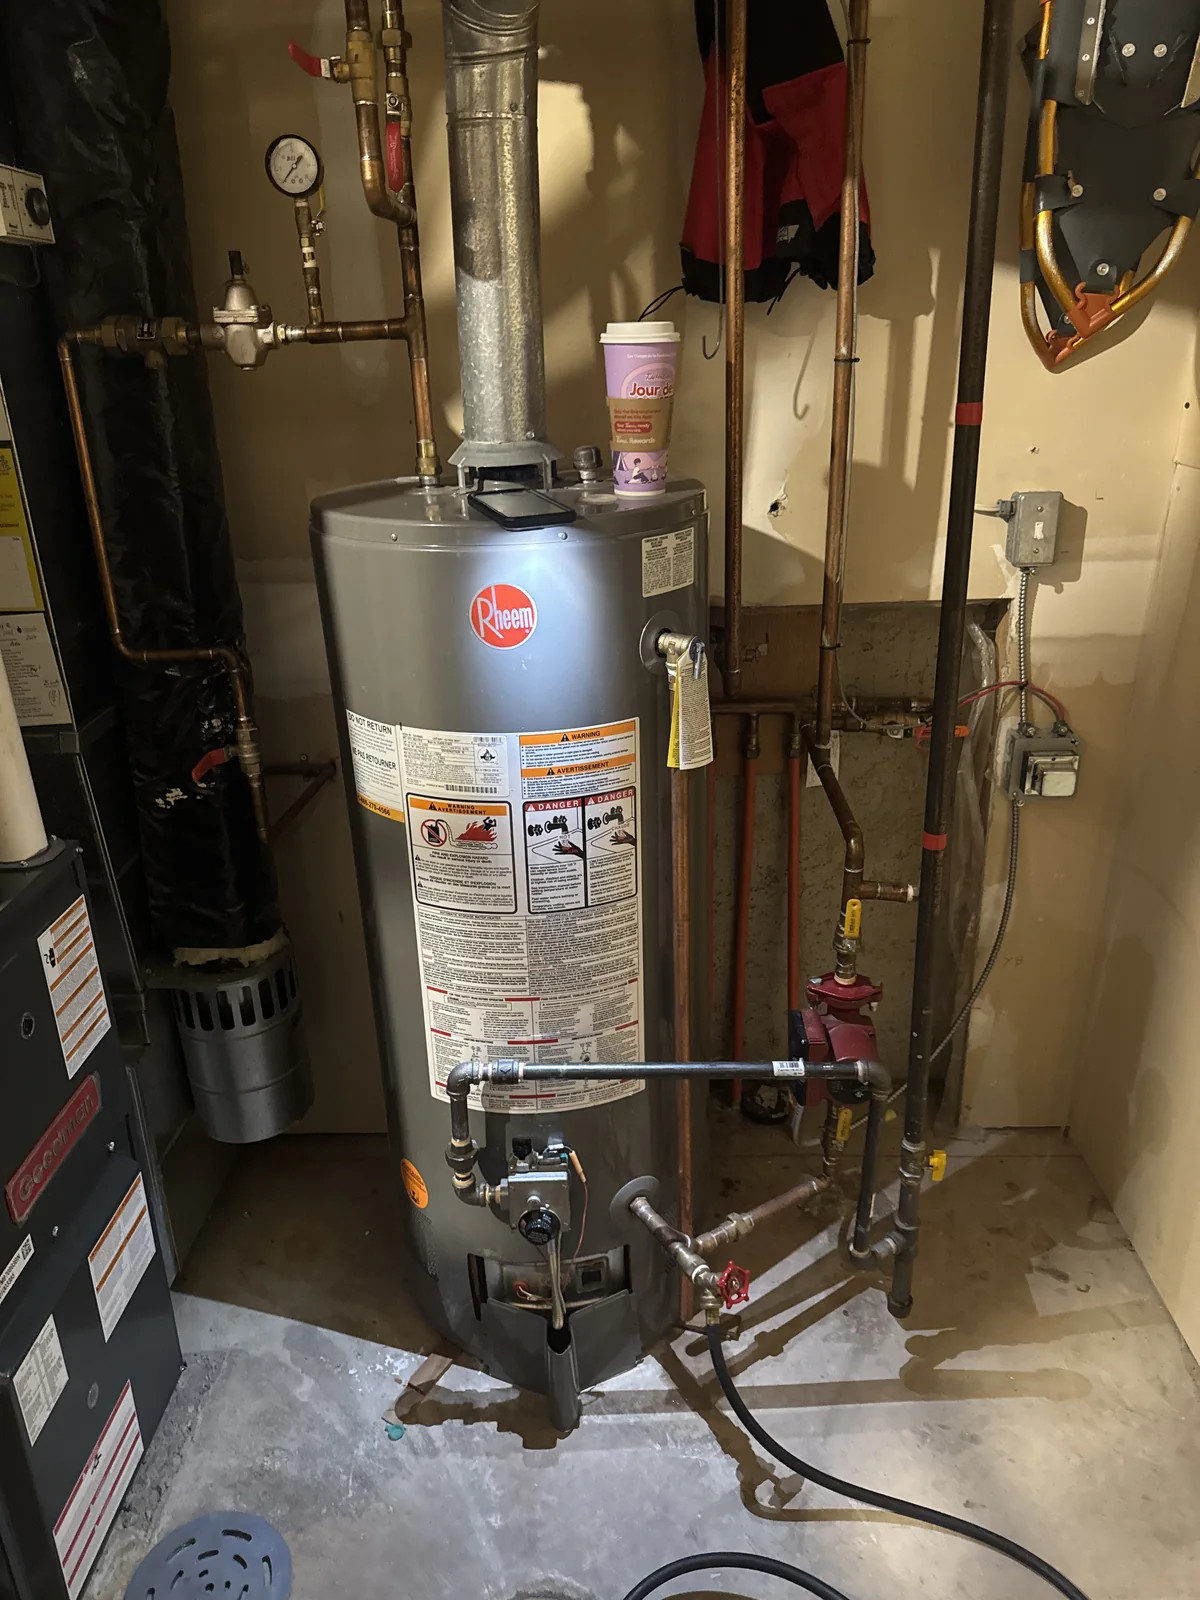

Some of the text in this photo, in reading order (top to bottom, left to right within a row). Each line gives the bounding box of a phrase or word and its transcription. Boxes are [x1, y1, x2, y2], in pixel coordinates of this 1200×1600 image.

[629, 382, 661, 397] Jour
[476, 585, 534, 639] Rheem
[348, 712, 392, 735] DO NOT RETURN
[571, 730, 600, 740] WARNING
[357, 750, 366, 760] PAS
[366, 753, 396, 770] RETOURNER
[556, 762, 609, 774] AVERTISSEMENT
[597, 790, 633, 803] DANGER
[438, 806, 486, 815] AVERTISSEMENT
[538, 800, 579, 810] DANGER
[19, 1094, 94, 1201] Goodman
